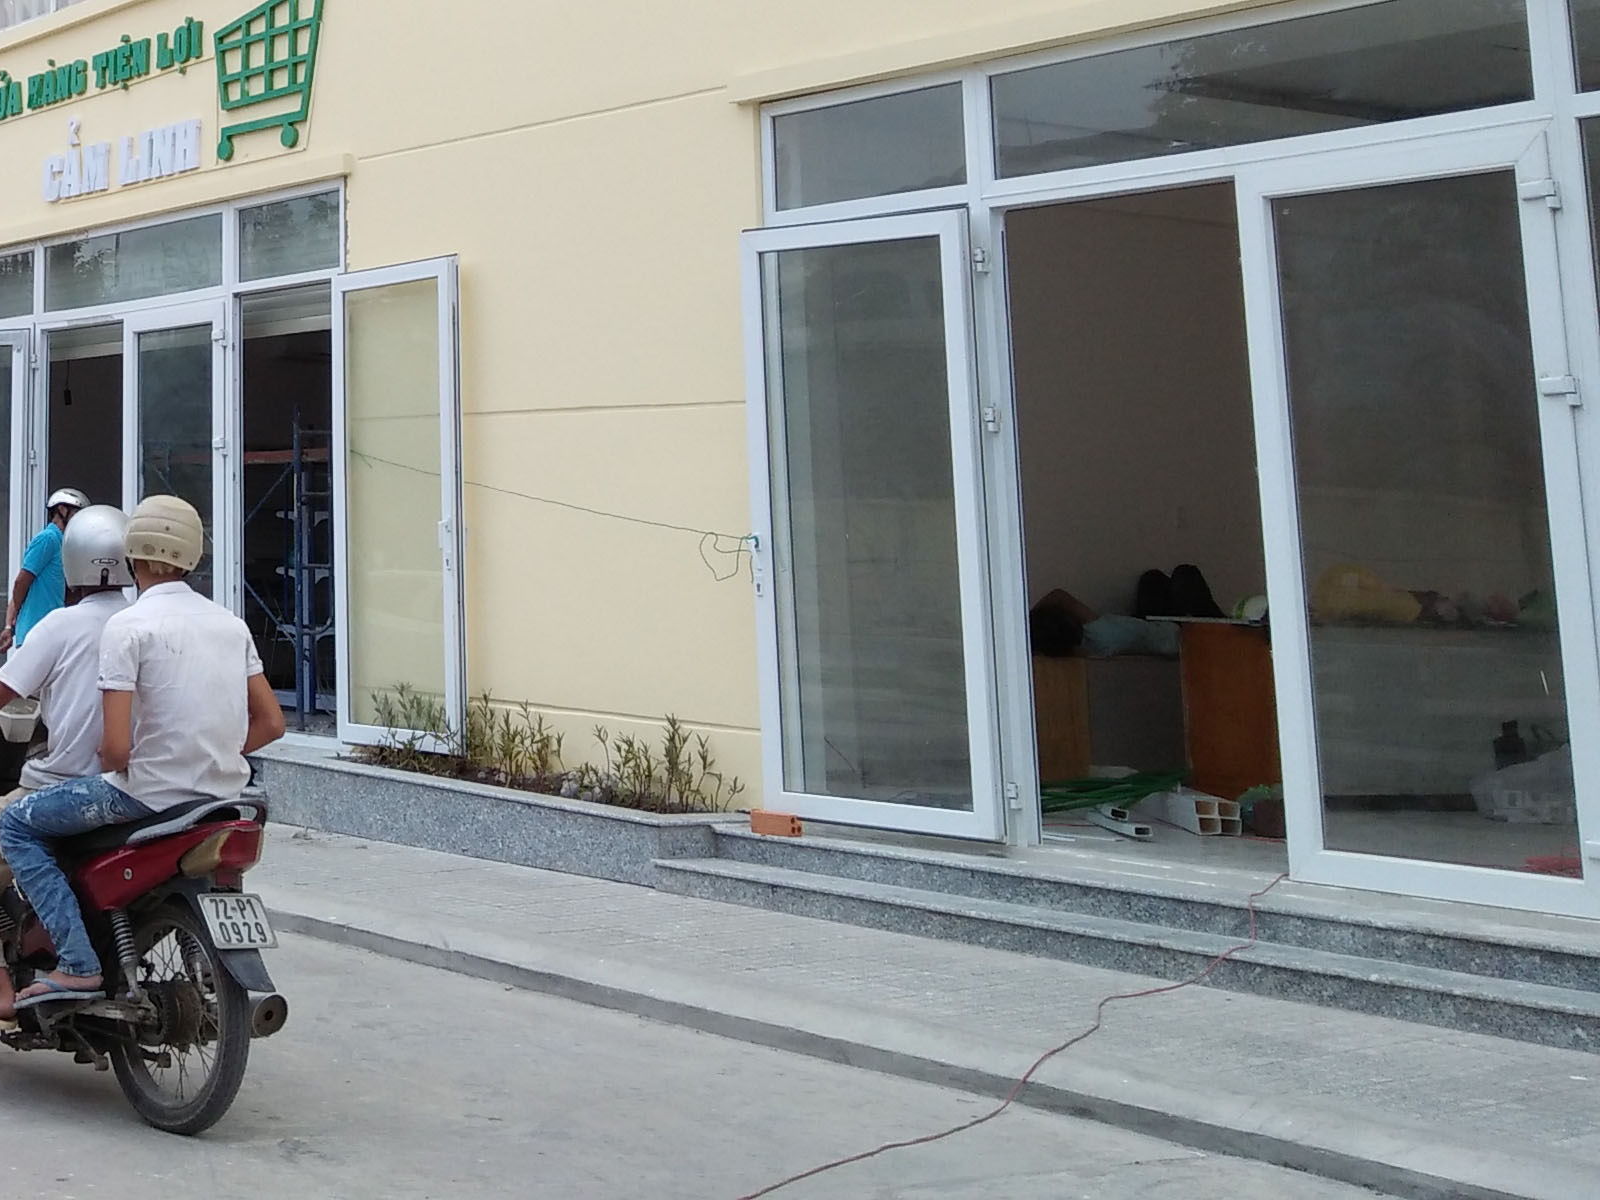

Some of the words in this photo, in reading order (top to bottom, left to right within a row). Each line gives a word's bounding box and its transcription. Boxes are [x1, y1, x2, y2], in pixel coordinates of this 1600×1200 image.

[92, 34, 151, 90] TIỆN
[156, 16, 204, 75] LỢI
[118, 119, 201, 186] LINH
[209, 898, 258, 919] 72-P1
[218, 921, 267, 943] 0929
